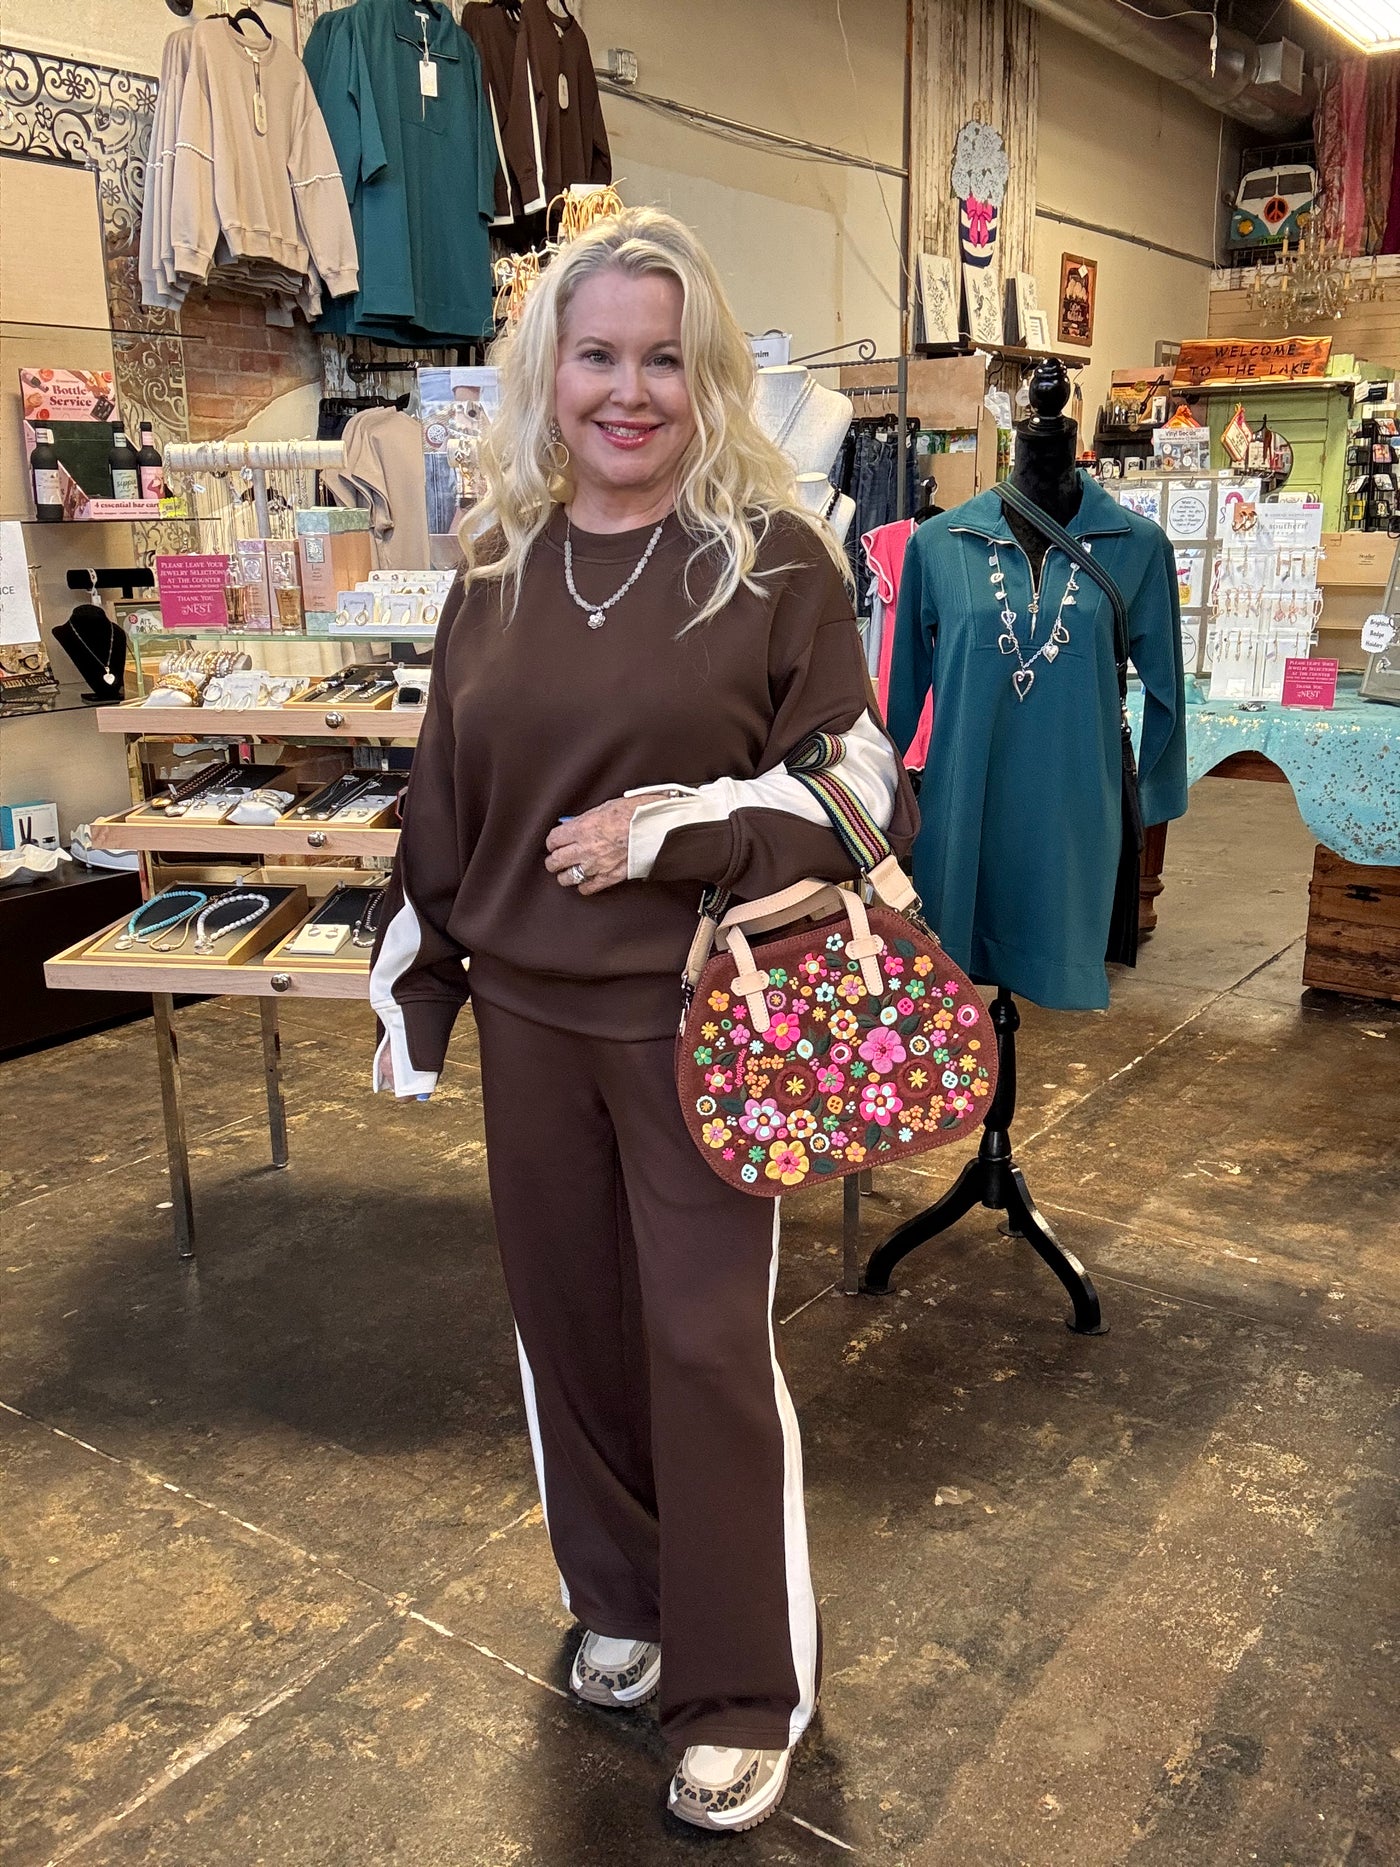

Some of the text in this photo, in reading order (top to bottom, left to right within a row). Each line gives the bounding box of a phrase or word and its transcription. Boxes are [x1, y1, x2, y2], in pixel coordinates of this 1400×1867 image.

[1215, 343, 1297, 358] WELCOME
[1190, 362, 1311, 377] TO THE LAKE
[52, 385, 87, 395] Bottle
[50, 396, 92, 406] Service
[0, 586, 15, 595] CE
[181, 603, 213, 616] NEST
[1296, 690, 1320, 699] NEST
